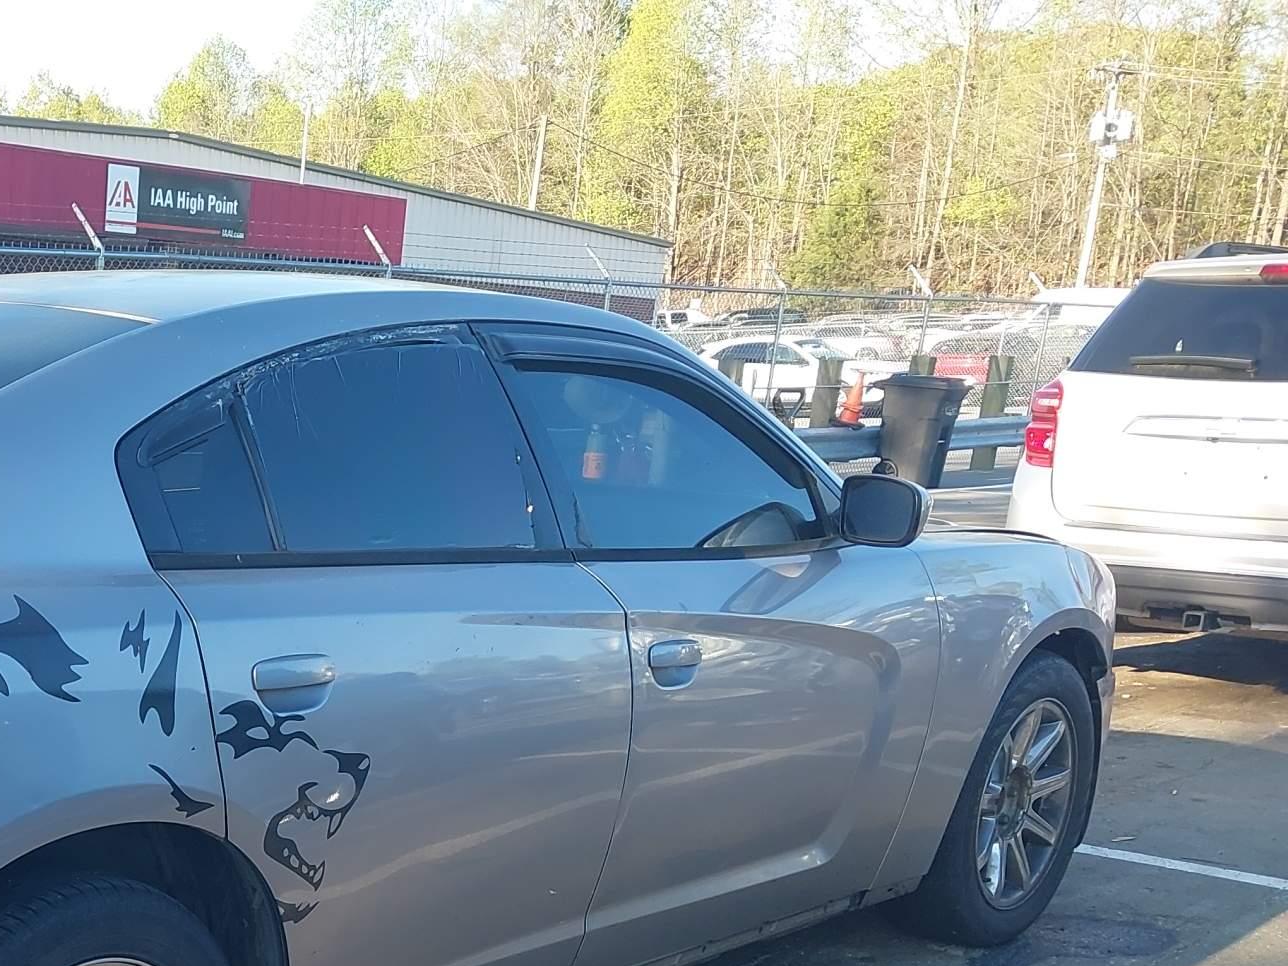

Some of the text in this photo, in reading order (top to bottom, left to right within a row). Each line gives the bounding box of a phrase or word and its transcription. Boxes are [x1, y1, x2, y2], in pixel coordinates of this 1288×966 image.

[150, 187, 238, 216] IAA High Point
